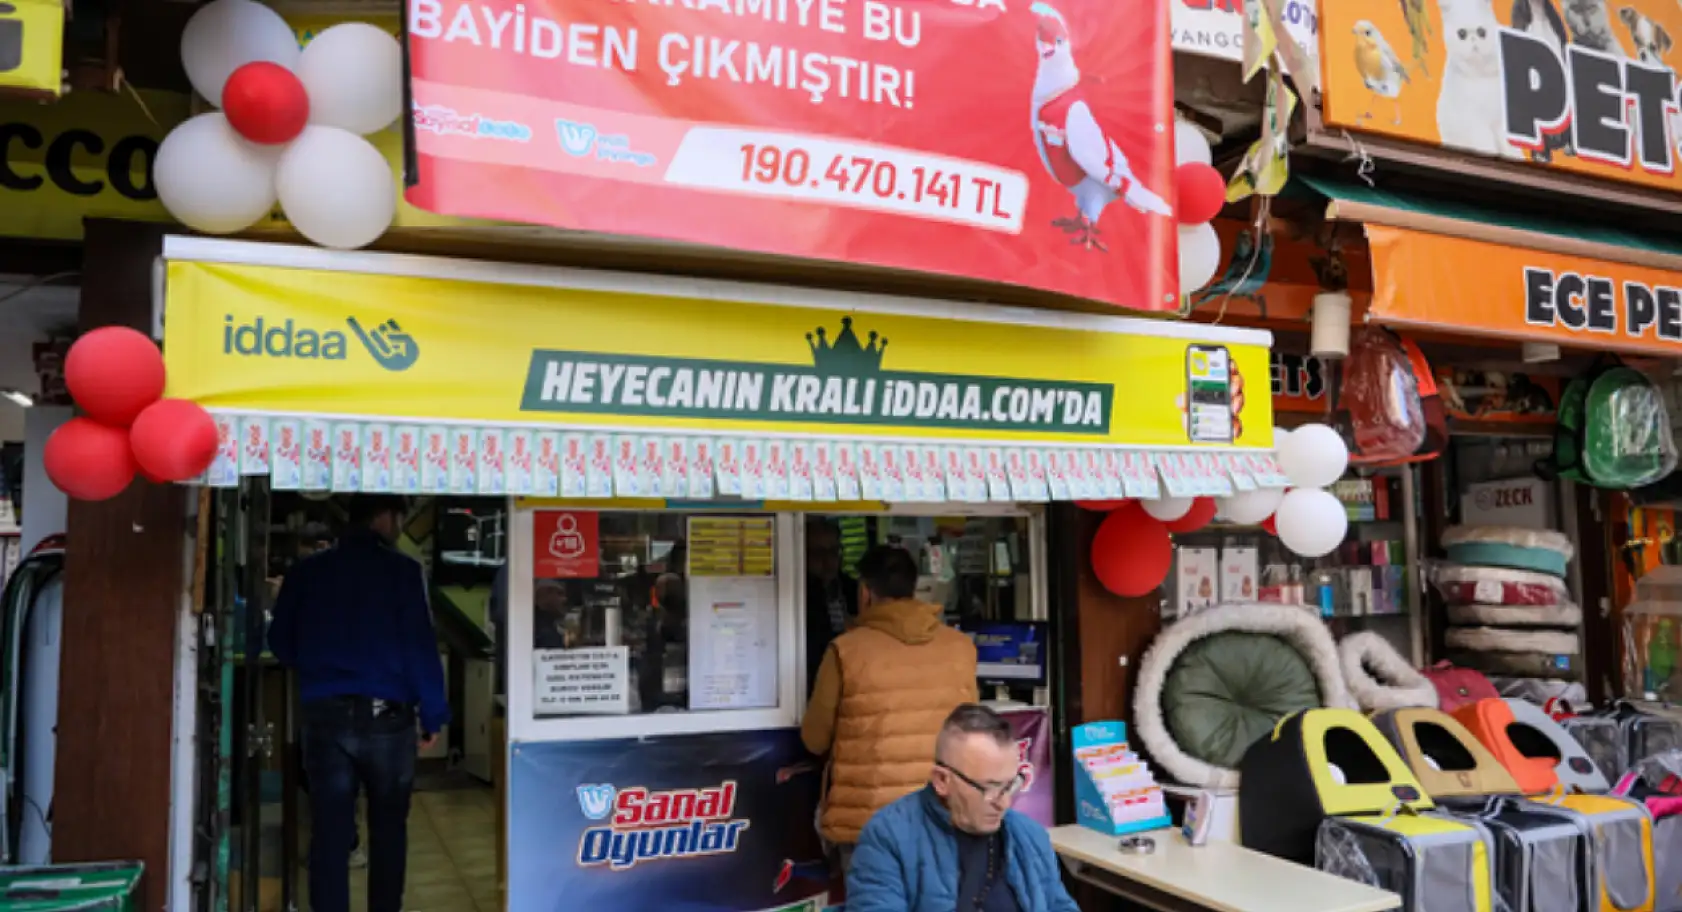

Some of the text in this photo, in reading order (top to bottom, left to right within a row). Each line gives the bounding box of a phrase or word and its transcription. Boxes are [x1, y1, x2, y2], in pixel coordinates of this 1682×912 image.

[863, 1, 921, 47] BU
[409, 0, 914, 109] BAYİDEN ÇIKMIŞTIR!
[1497, 26, 1682, 177] PET
[740, 144, 1011, 219] 190.470.141 TL
[1523, 265, 1617, 335] ECE
[224, 314, 347, 360] iddaa
[540, 360, 764, 411] HEYECANIN
[770, 373, 876, 416] KRALI
[613, 780, 738, 827] Sanal
[577, 819, 749, 870] Oyunlar
